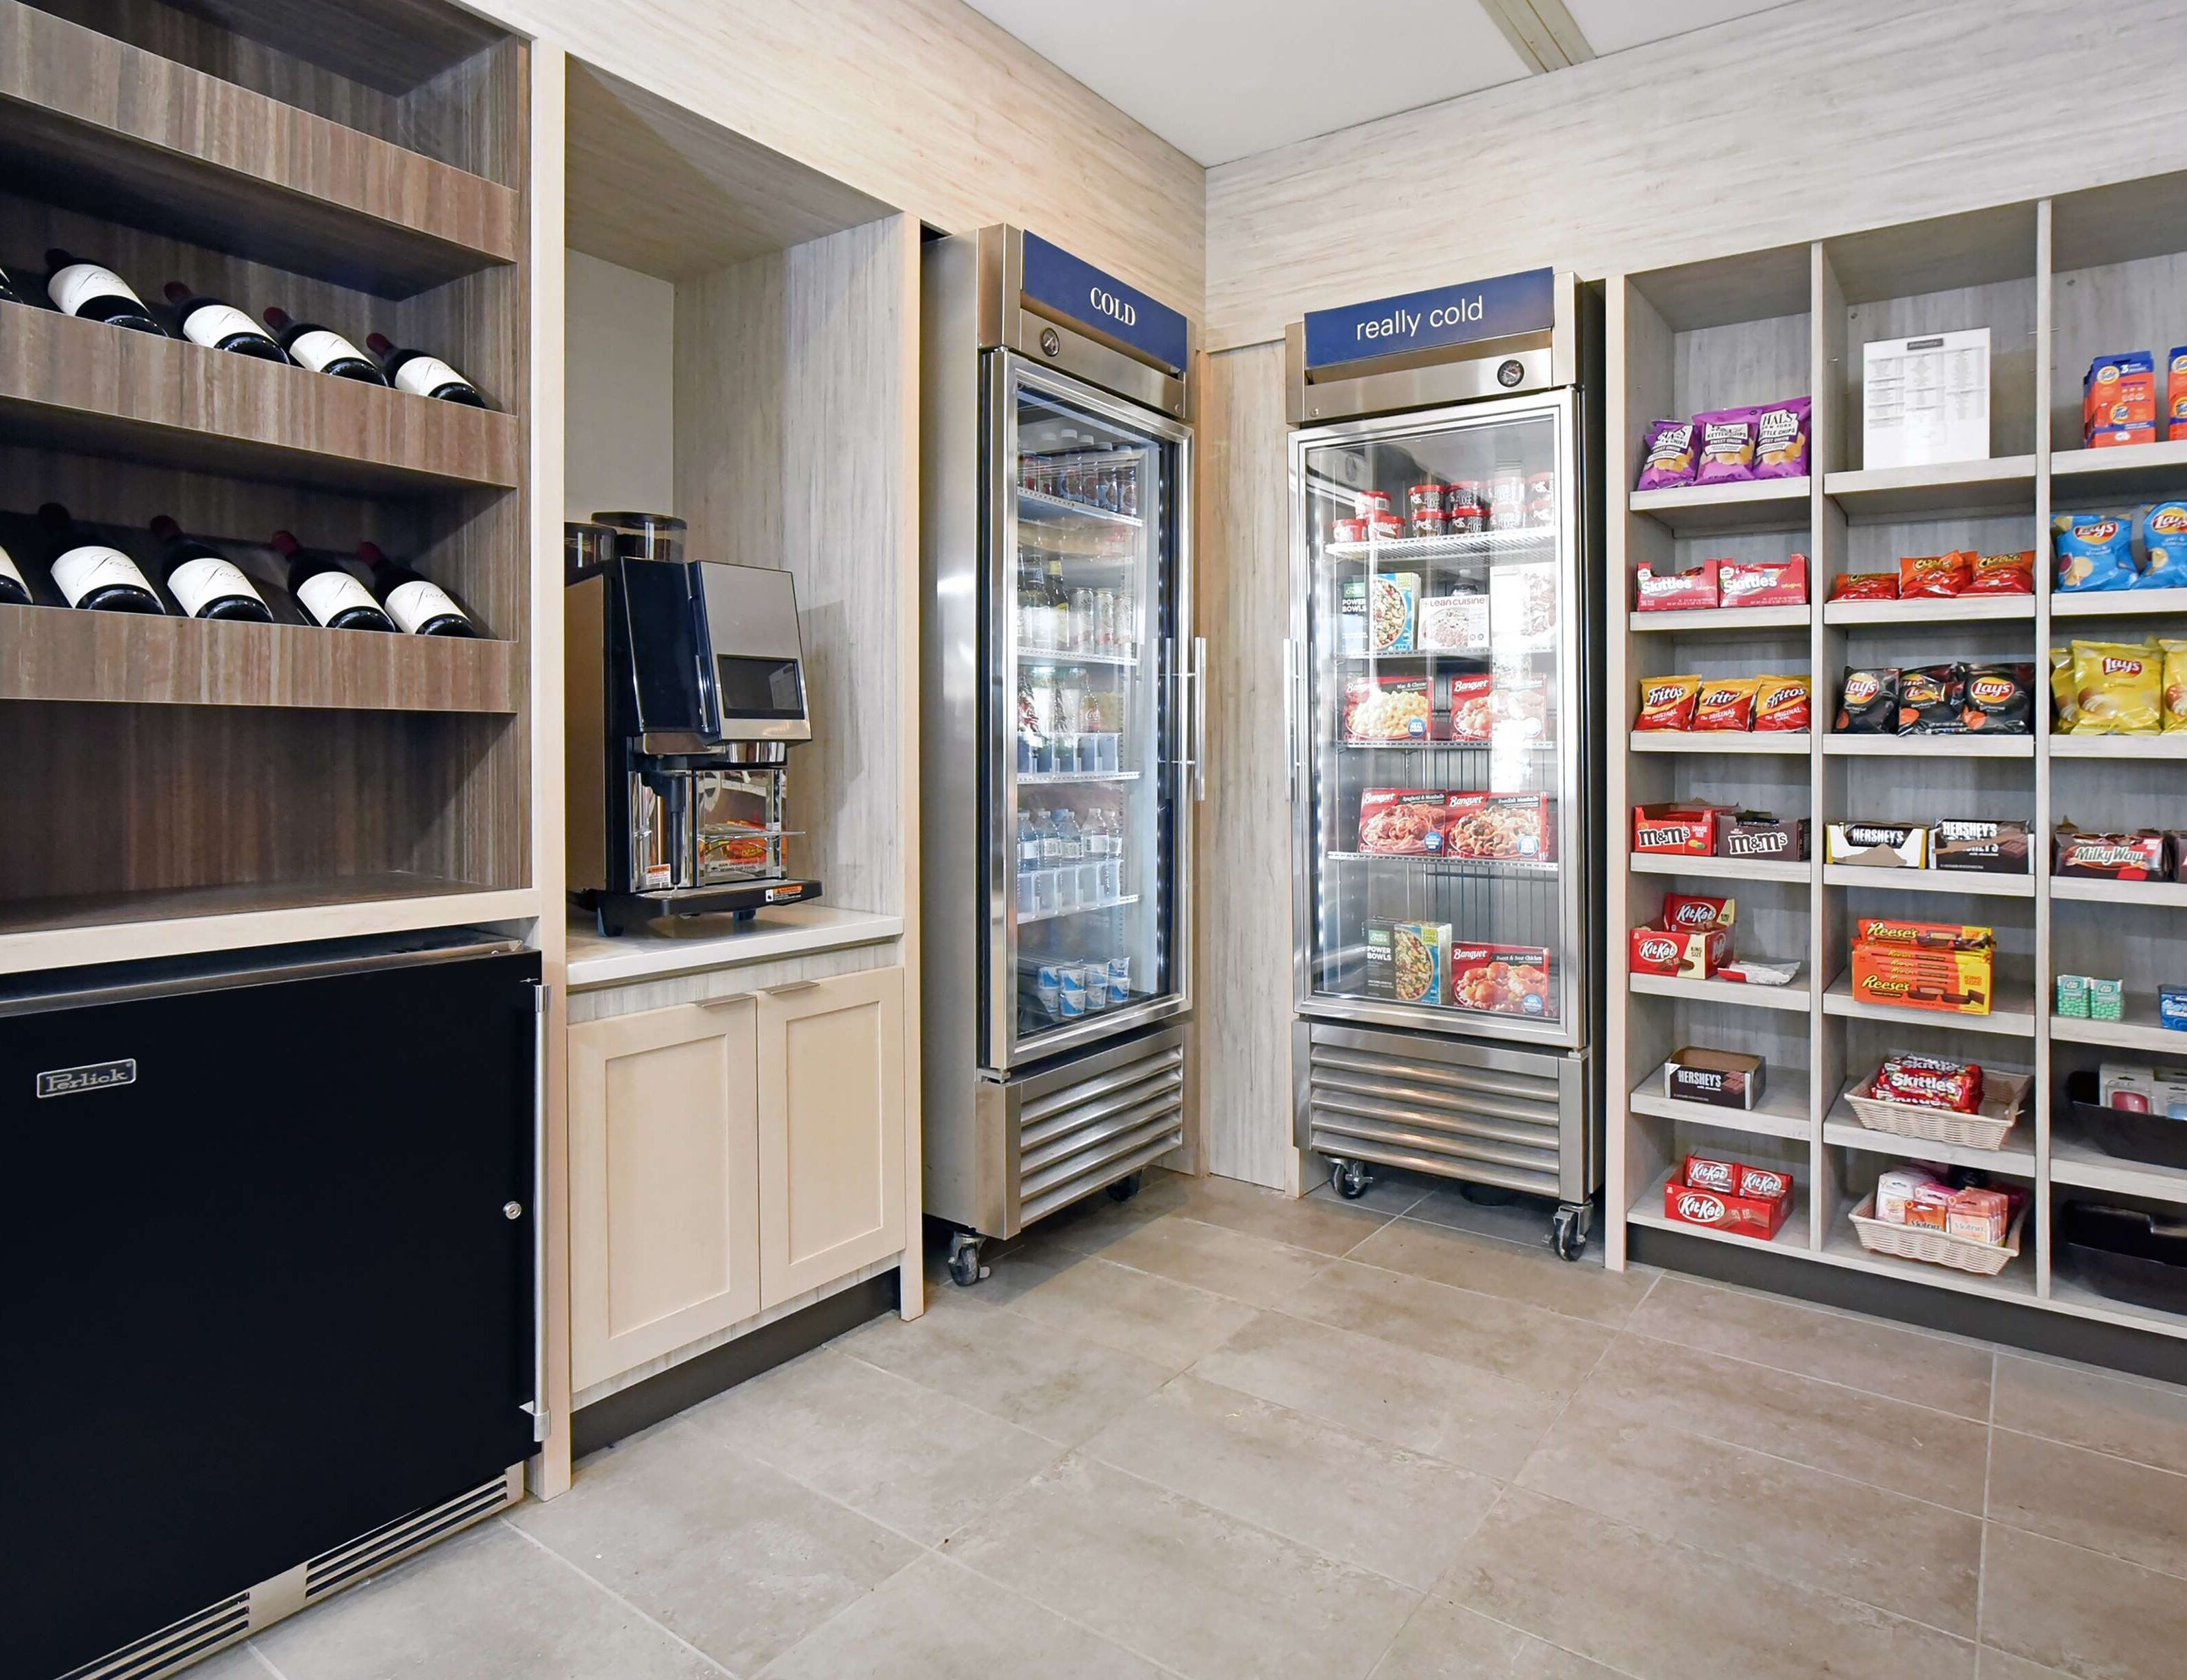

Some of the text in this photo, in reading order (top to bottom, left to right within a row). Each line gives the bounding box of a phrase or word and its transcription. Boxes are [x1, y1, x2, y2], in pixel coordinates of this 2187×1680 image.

[1090, 287, 1136, 326] COLD
[1356, 295, 1483, 341] really cold
[1641, 578, 1692, 595] Skittles
[1723, 575, 1778, 594] Skittles
[1453, 679, 1489, 692] Banquet
[1645, 686, 1685, 706] Fritos
[1766, 687, 1805, 708] Fritos
[1449, 795, 1485, 807] Banquet
[1638, 827, 1690, 847] m&m's
[1852, 828, 1905, 844] HERSHEY'S
[1942, 822, 1997, 838] HERSHEY'S
[1729, 832, 1788, 854] m&m's
[2076, 845, 2144, 865] Milky Way
[1867, 922, 1918, 939] Reese's
[1367, 945, 1392, 954] POWER
[1367, 952, 1392, 961] BOWLS
[1453, 948, 1487, 960] Banquet
[1862, 974, 1910, 991] Reese's
[45, 1068, 129, 1093] Perlick
[1678, 1070, 1722, 1088] HERSHEY'S
[1890, 1072, 1956, 1095] Skittles
